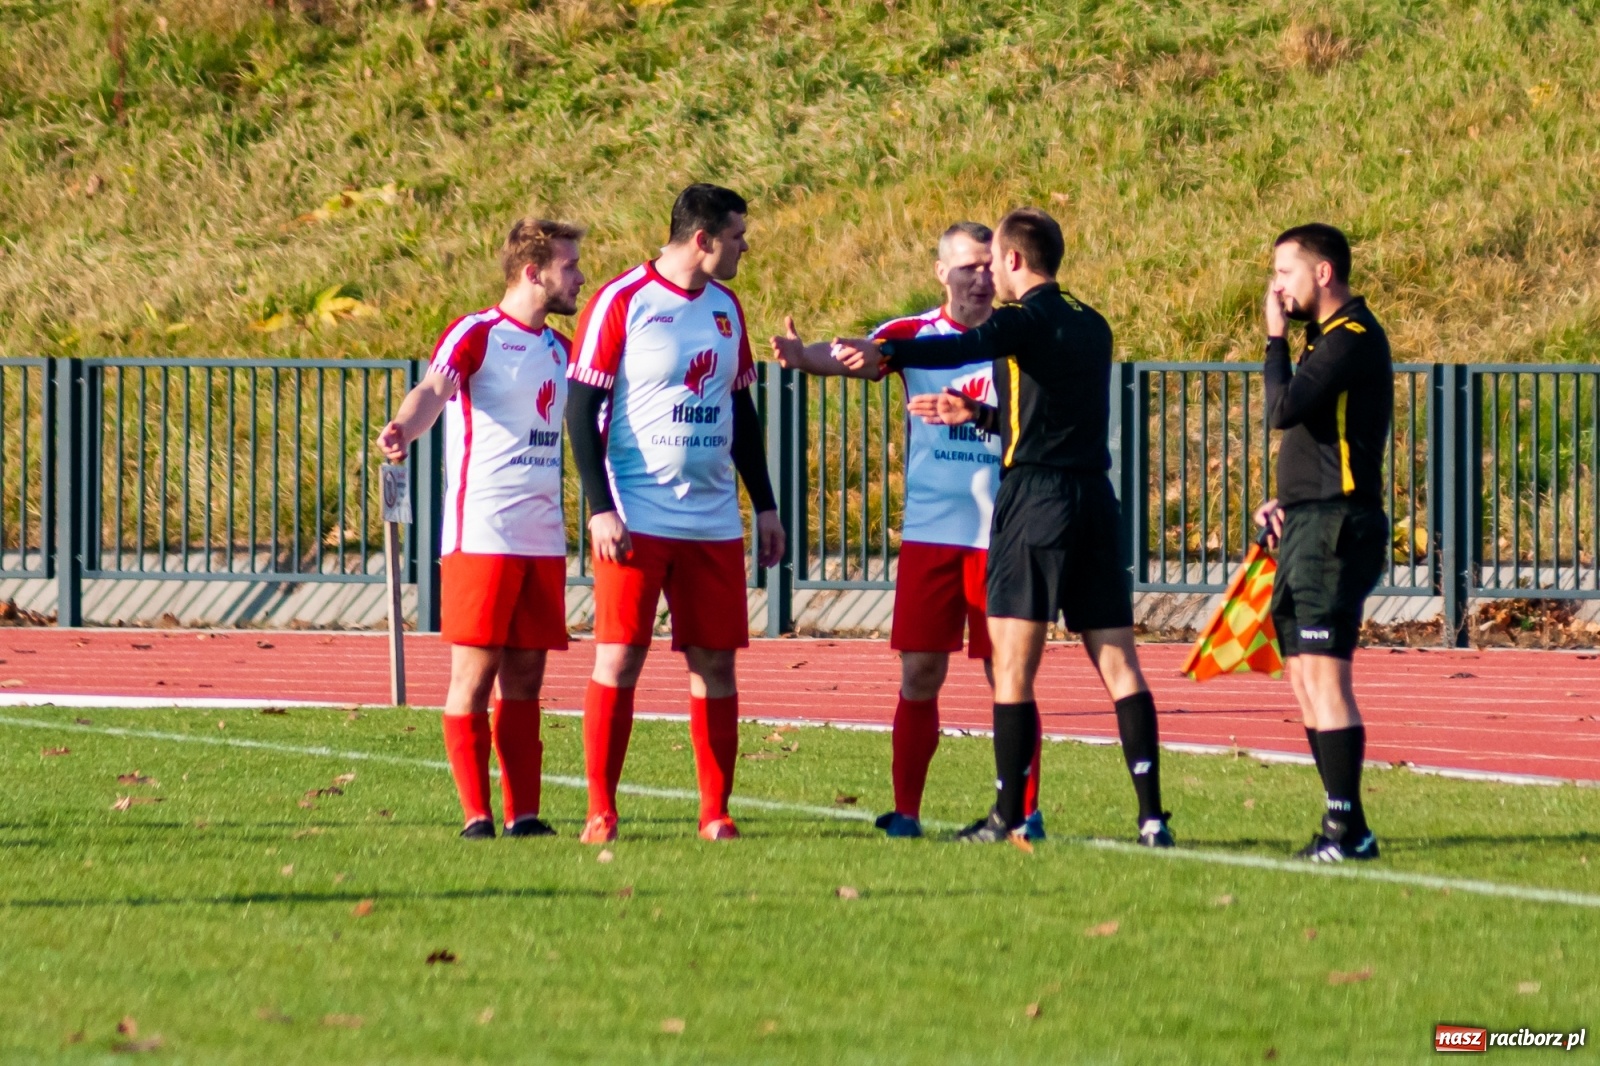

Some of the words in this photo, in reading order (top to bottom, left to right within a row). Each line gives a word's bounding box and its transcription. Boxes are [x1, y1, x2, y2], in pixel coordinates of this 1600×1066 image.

[672, 402, 720, 424] Husar
[651, 434, 701, 447] GALERIA
[934, 449, 975, 463] GALERIA
